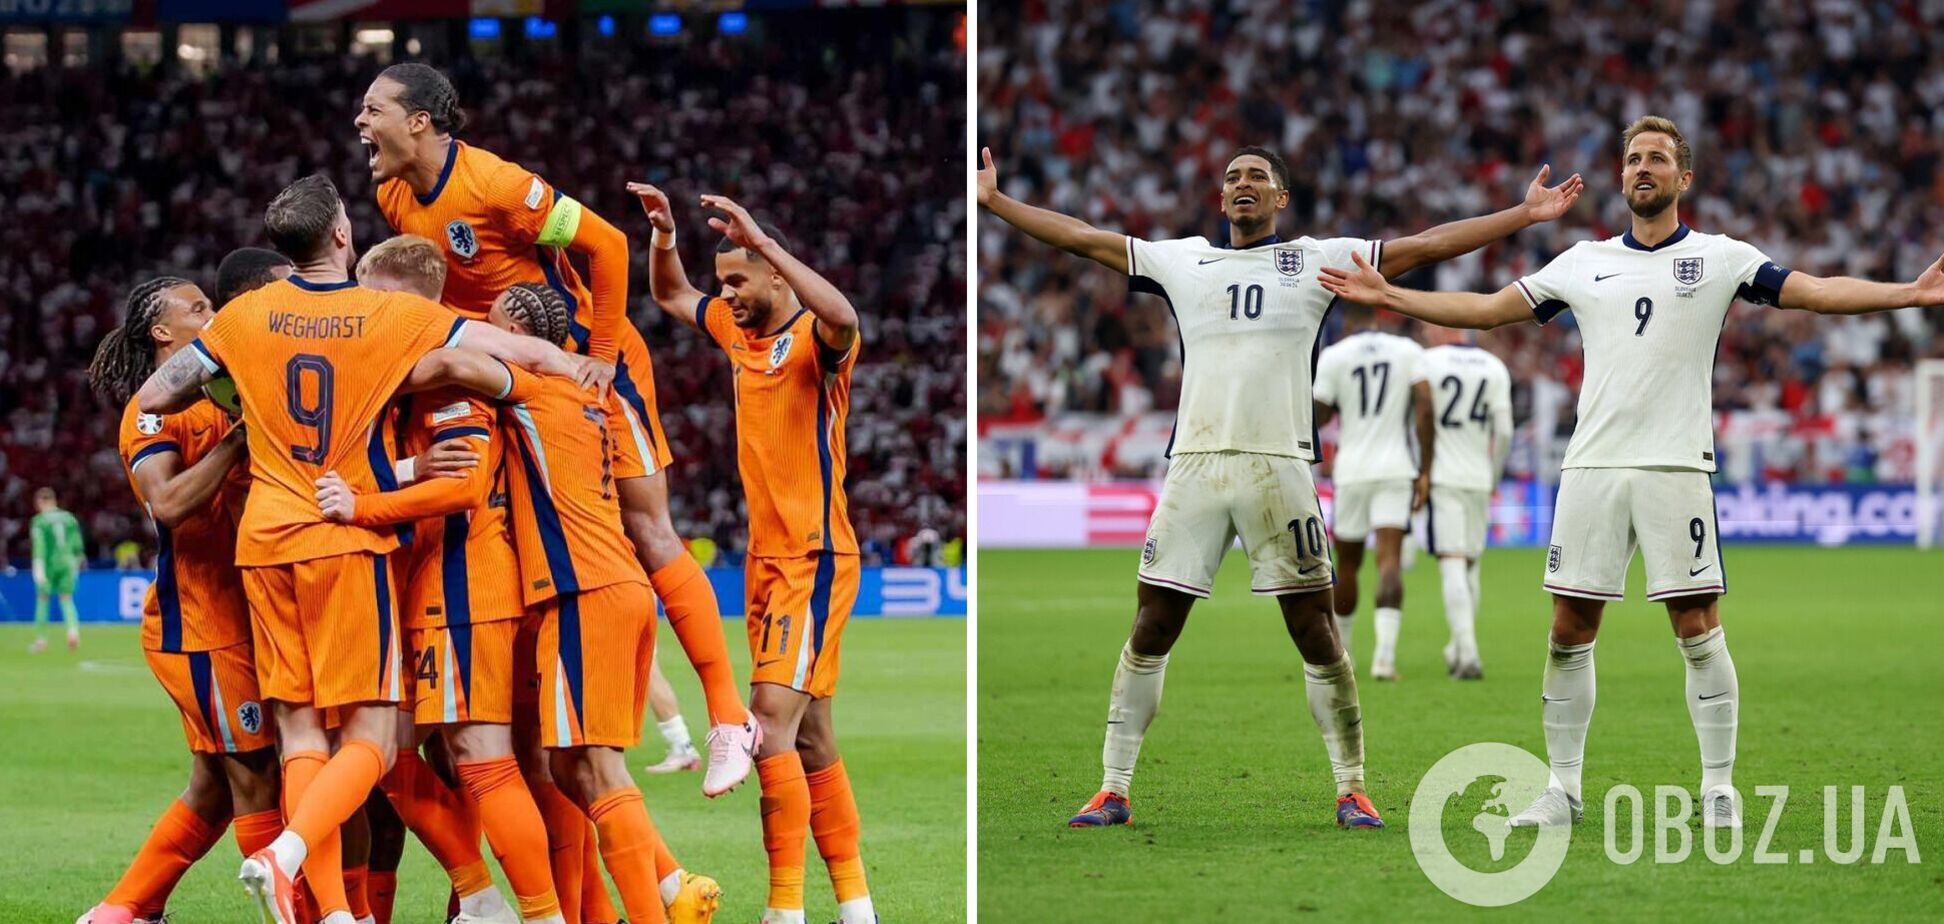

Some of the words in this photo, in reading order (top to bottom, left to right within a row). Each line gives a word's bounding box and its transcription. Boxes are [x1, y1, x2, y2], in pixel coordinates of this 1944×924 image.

[1226, 284, 1265, 320] 10
[1635, 296, 1654, 336] 9
[269, 311, 366, 339] WEGHORST
[286, 353, 335, 466] 9
[1352, 362, 1390, 418] 17
[1441, 375, 1490, 429] 24
[1714, 481, 1928, 546] oking.co
[1287, 516, 1322, 560] 10
[1690, 517, 1706, 559] 9
[761, 612, 792, 655] 11
